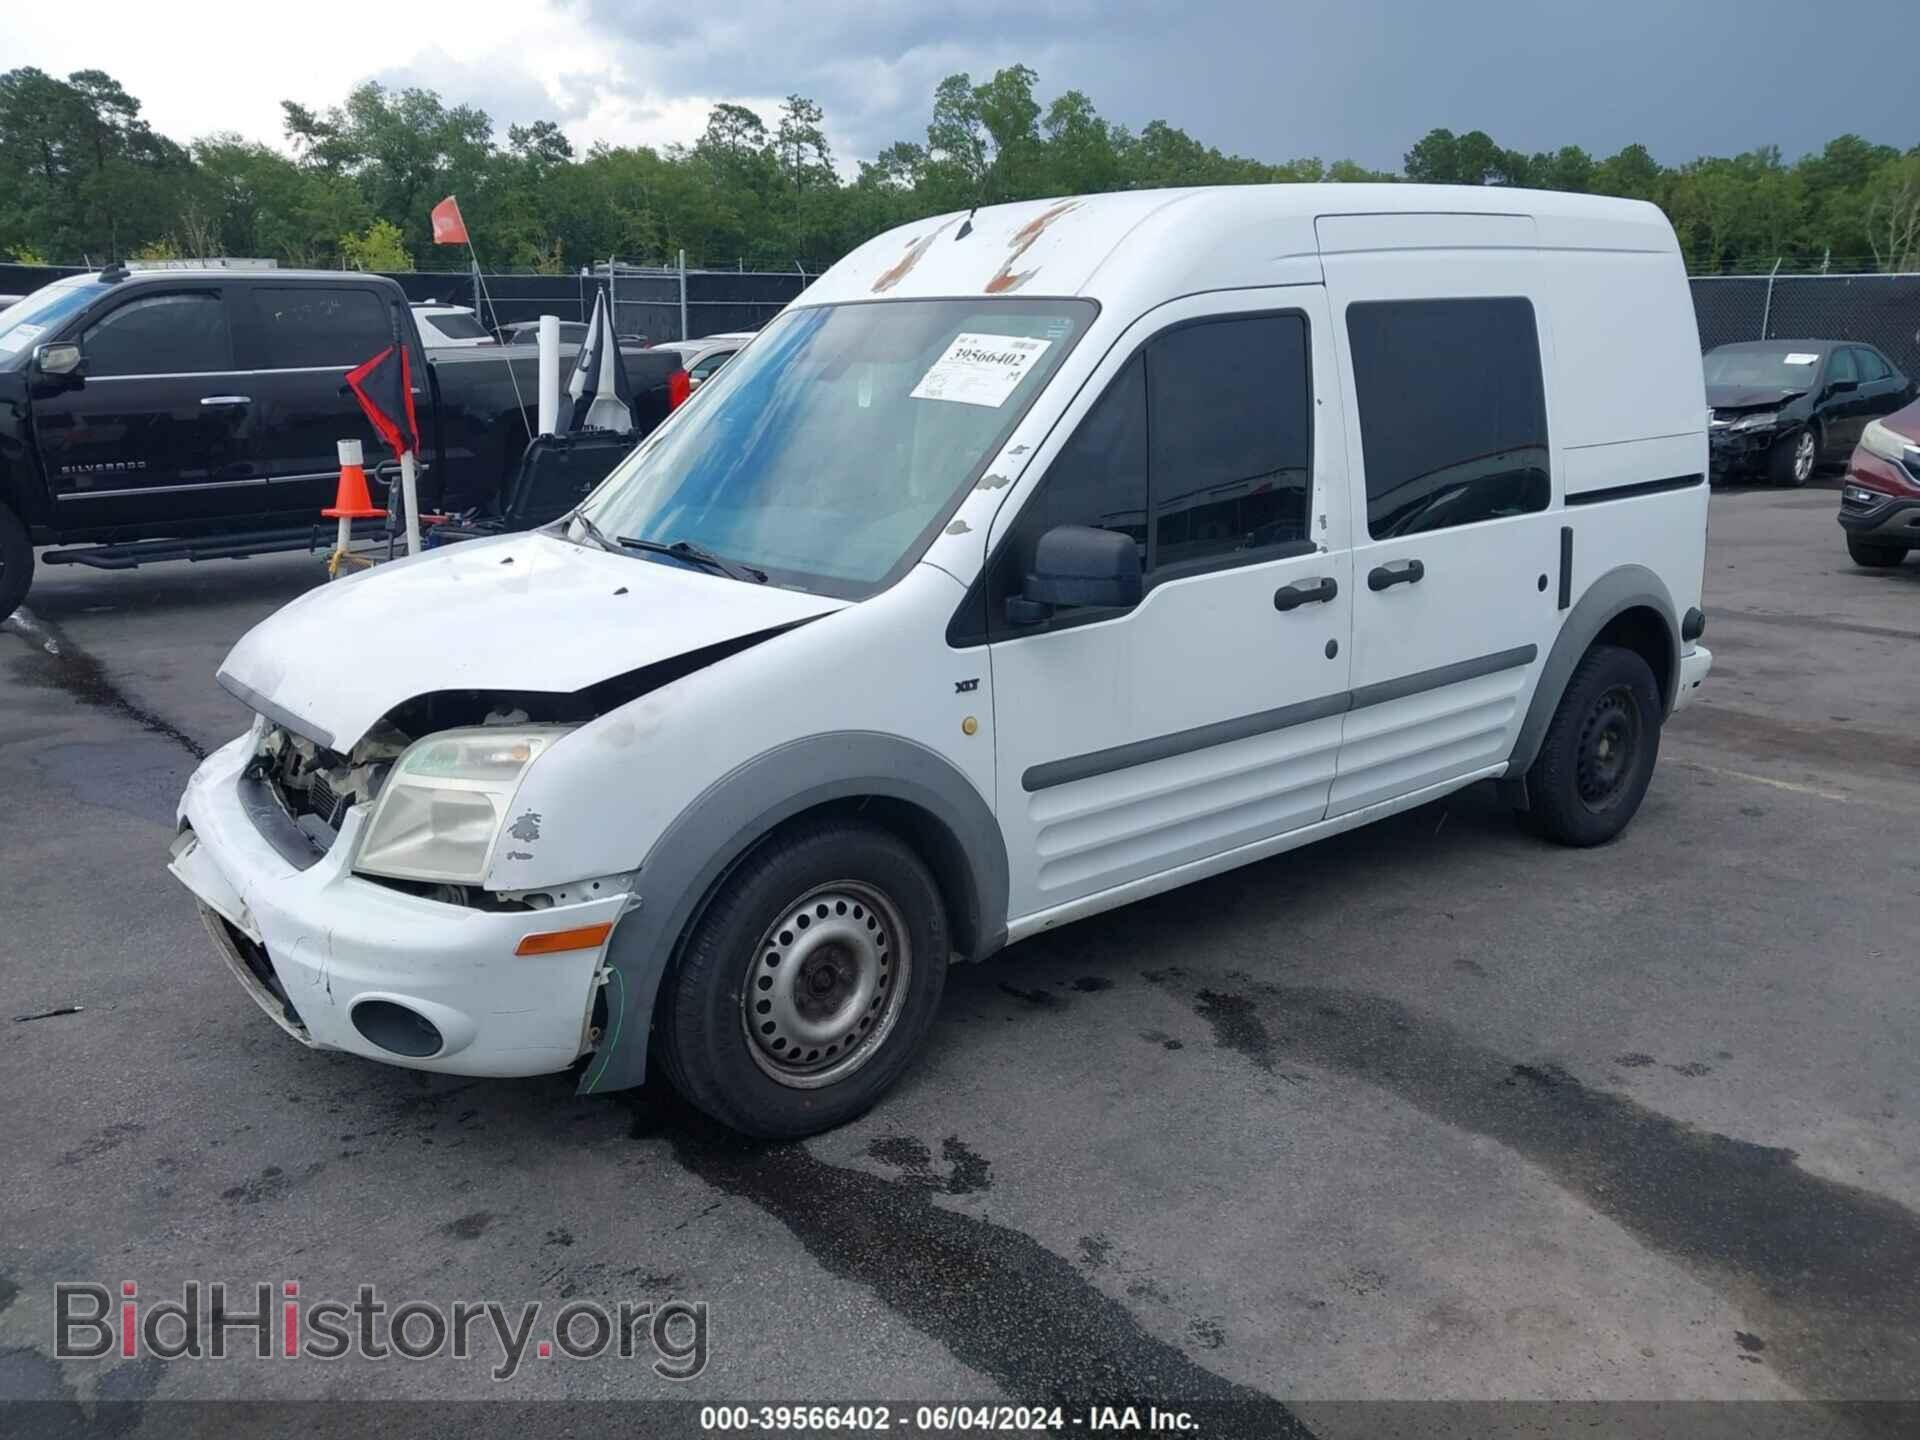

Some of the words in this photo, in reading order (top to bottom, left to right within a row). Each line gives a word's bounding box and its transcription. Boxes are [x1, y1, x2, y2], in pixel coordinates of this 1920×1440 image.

[950, 348, 1026, 367] 39566402
[62, 461, 146, 473] SILVERADO
[955, 678, 980, 694] XLT
